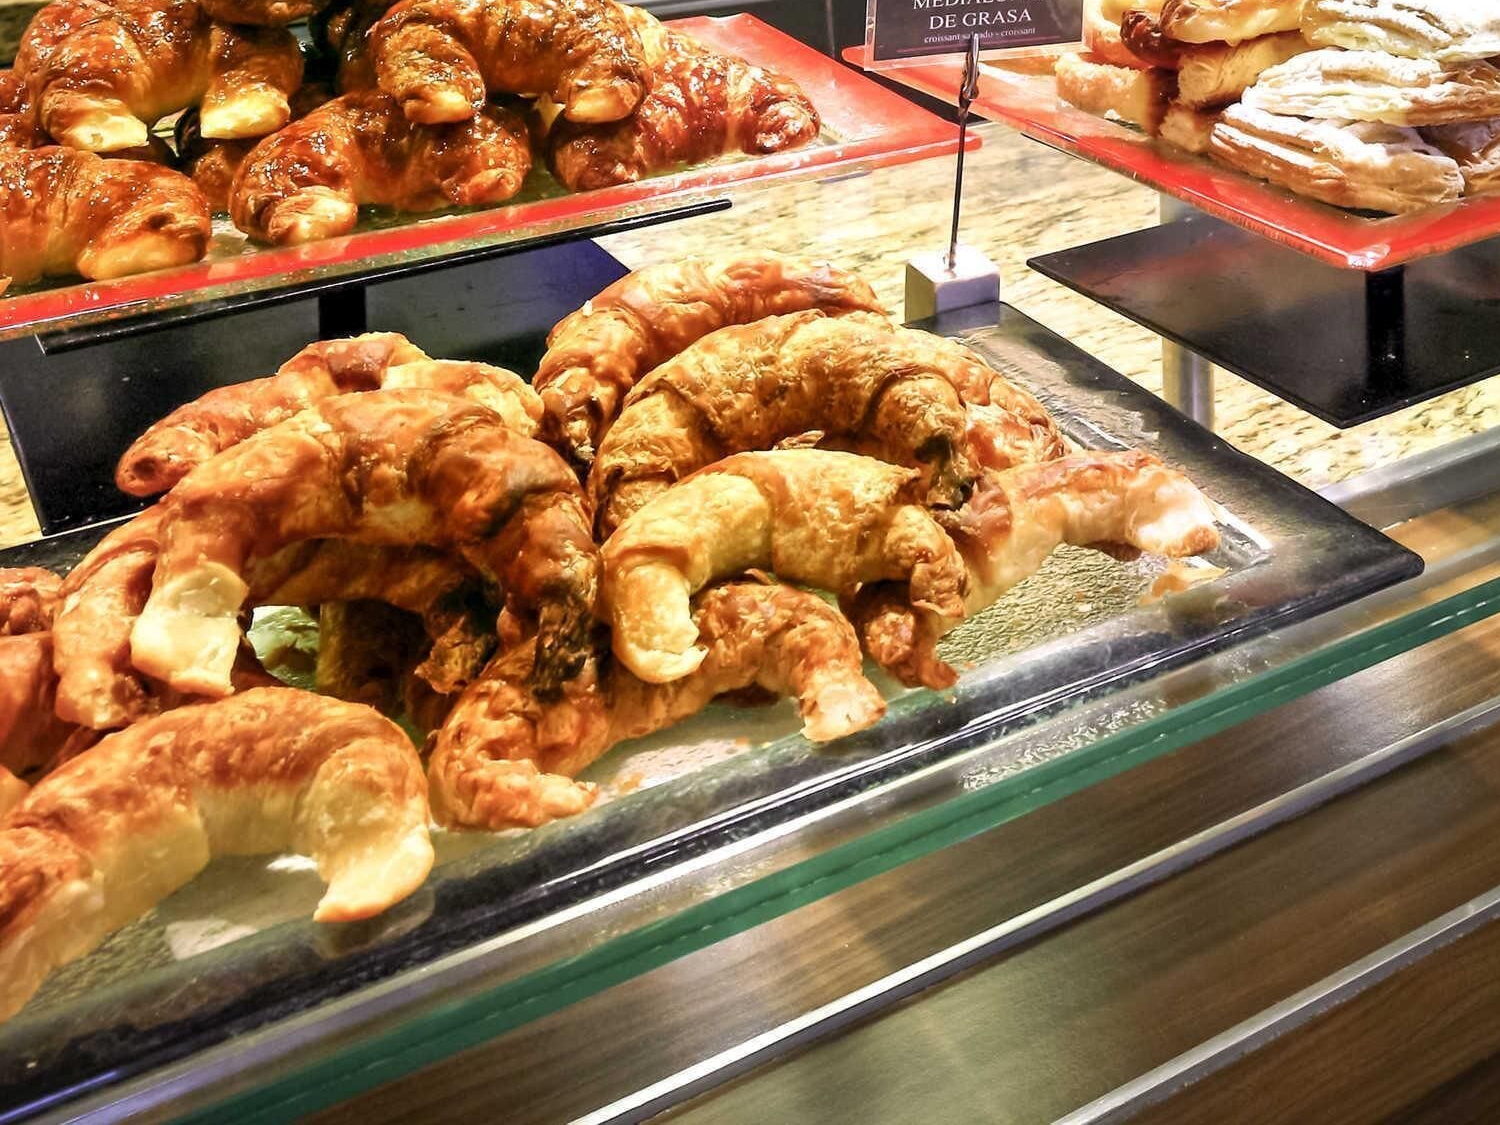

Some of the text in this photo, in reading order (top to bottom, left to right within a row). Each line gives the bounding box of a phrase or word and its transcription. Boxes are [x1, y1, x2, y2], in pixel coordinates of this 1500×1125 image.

[929, 9, 1033, 31] DE GRASA
[924, 33, 961, 44] croissant
[1000, 26, 1037, 37] croissant
